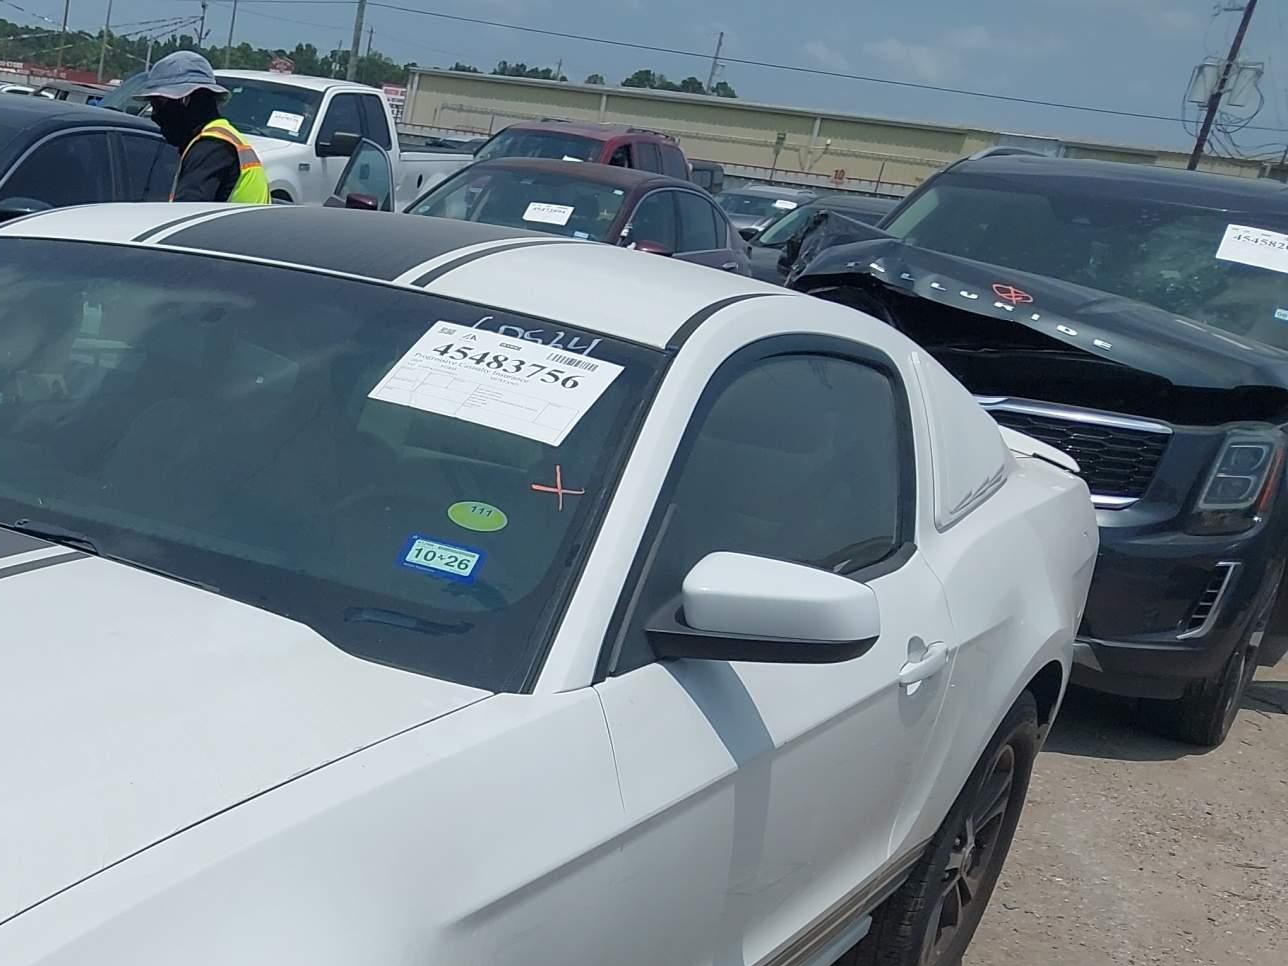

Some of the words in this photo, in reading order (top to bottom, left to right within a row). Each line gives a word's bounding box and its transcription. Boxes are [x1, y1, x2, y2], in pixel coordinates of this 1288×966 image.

[1233, 234, 1288, 250] 454582
[414, 352, 459, 366] Progressive
[459, 362, 490, 374] Casualty
[492, 371, 529, 383] Insurance
[432, 342, 586, 390] 45483756
[414, 547, 437, 562] 10
[443, 555, 471, 571] 26
